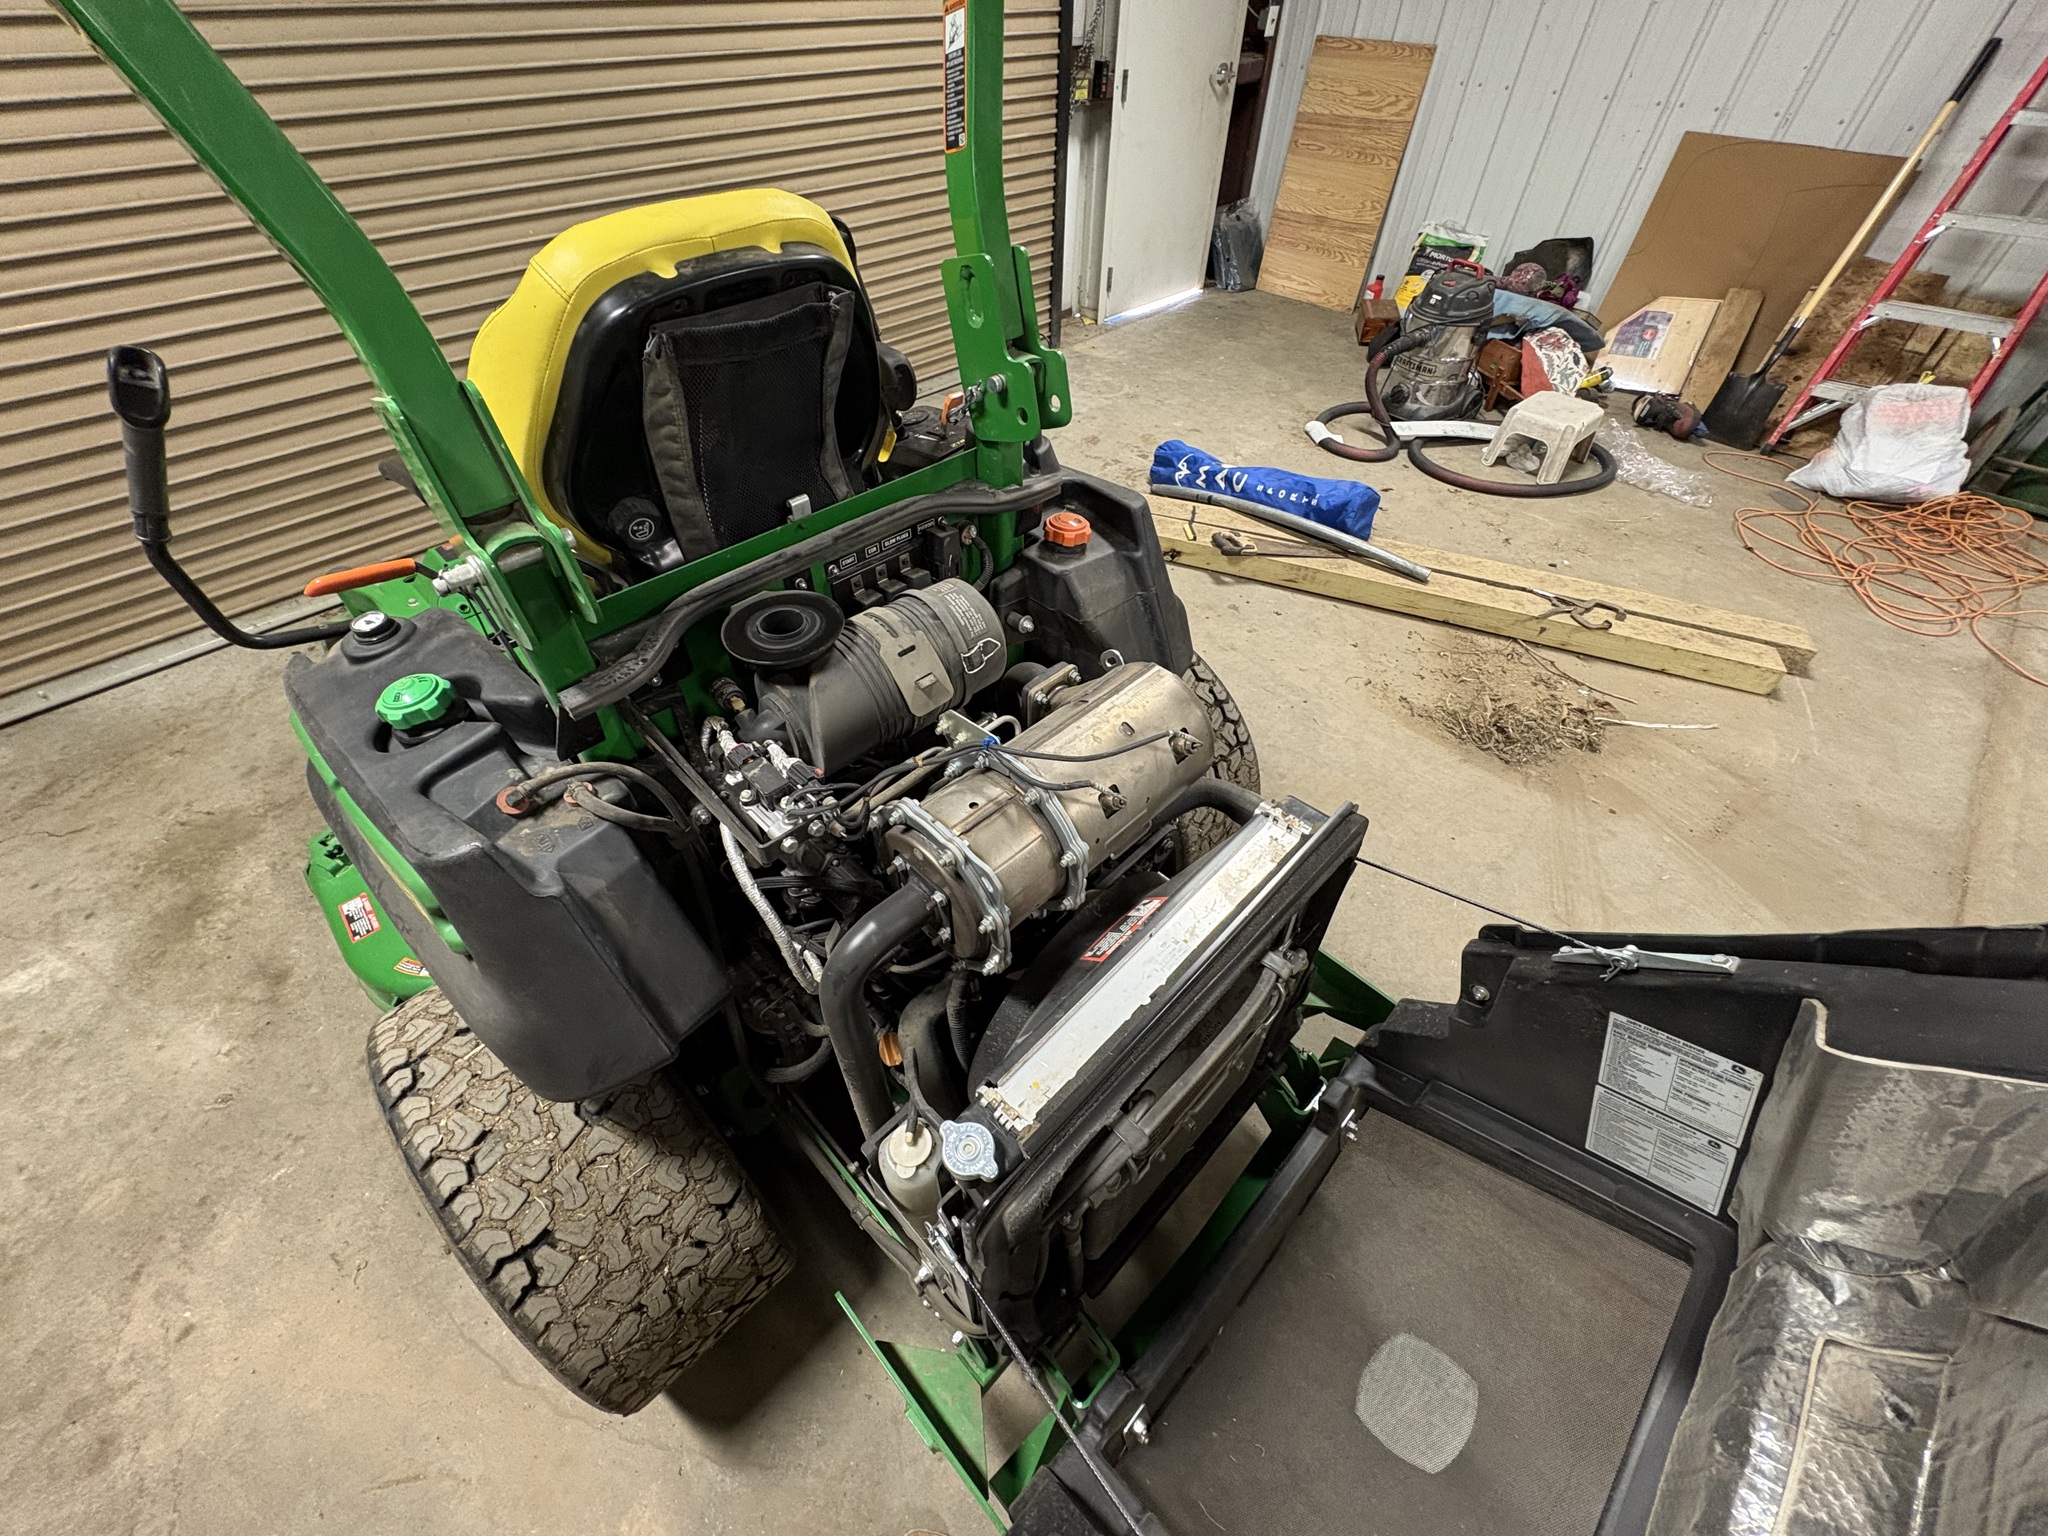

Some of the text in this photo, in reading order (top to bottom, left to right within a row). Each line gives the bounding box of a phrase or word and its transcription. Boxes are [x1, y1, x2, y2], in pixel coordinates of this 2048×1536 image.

[1429, 250, 1454, 262] MORTO
[1196, 466, 1318, 506] MAC SPORTS
[842, 556, 855, 566] START
